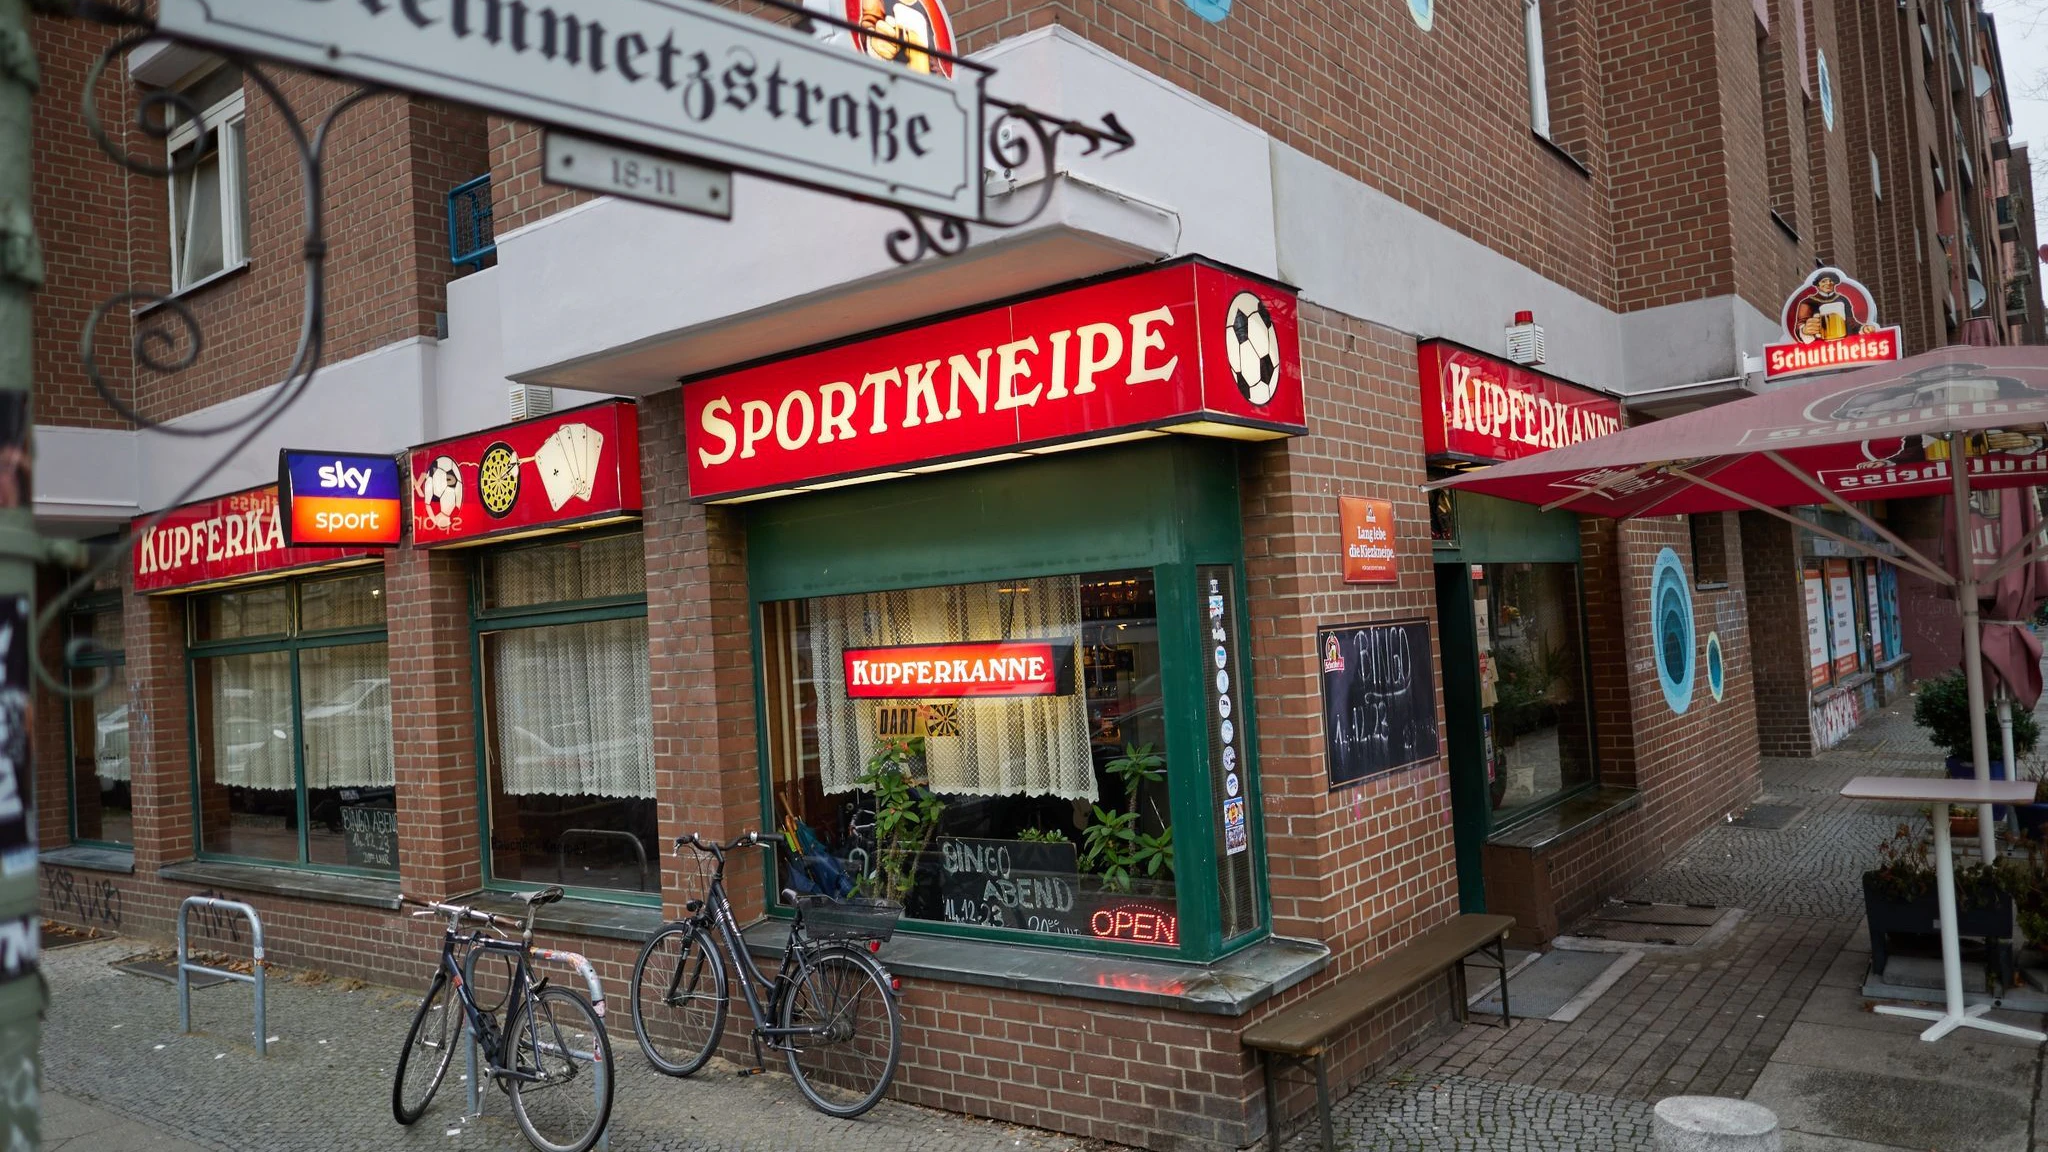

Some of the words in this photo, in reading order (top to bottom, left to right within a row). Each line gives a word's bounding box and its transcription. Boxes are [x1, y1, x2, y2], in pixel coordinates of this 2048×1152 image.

[298, 0, 931, 165] einmetzstraße
[611, 157, 677, 196] 18-11
[1771, 338, 1890, 370] Schultheiss
[698, 305, 1179, 469] SPORTKNEIPE
[318, 461, 372, 496] sky
[315, 510, 380, 531] sport
[1357, 526, 1373, 542] Lang
[139, 504, 286, 574] KUPFERKA
[852, 656, 1047, 685] KUPFERKANNE
[879, 707, 918, 735] DART
[342, 809, 370, 833] BINGO
[942, 839, 1012, 879] BINGO
[983, 877, 1074, 912] ABEND
[1091, 910, 1177, 943] OPEN
